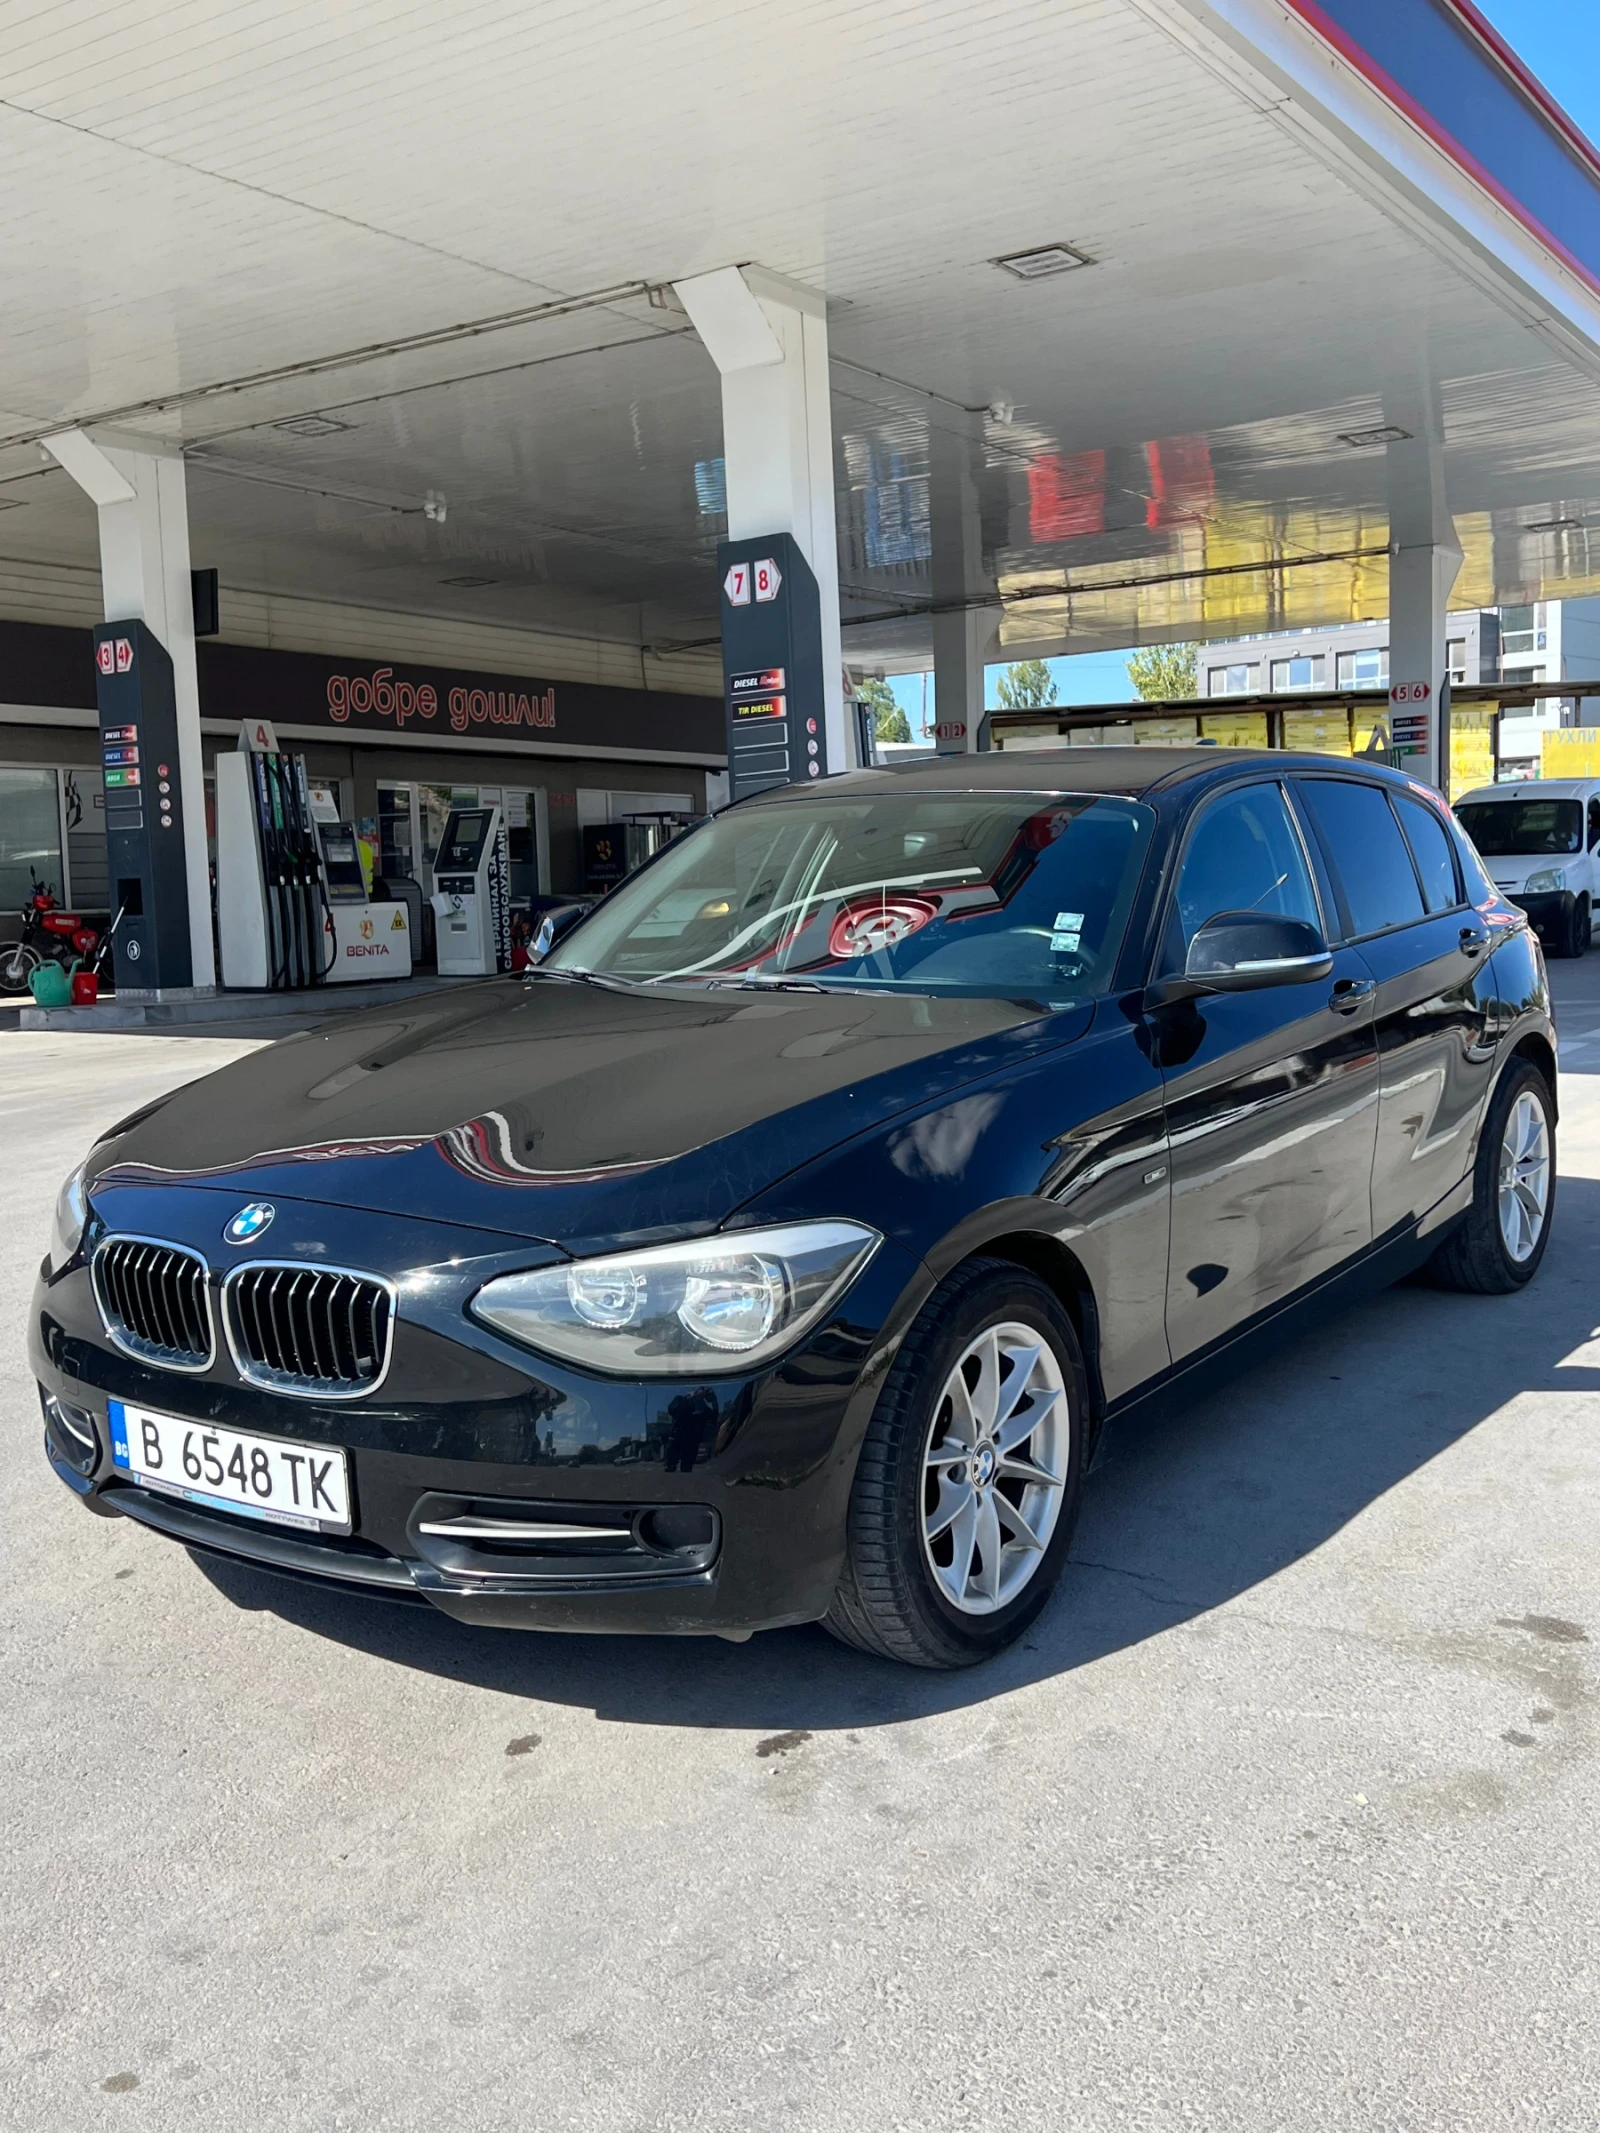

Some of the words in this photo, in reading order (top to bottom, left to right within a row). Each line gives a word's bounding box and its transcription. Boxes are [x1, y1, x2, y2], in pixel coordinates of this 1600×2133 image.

[734, 572, 744, 595] 7
[758, 569, 768, 591] 8
[103, 648, 110, 666] 3
[118, 646, 125, 664] 4
[733, 678, 758, 689] DIESEL
[1414, 685, 1421, 698] 6
[327, 667, 438, 726] добре
[449, 687, 556, 731] дошли!
[1399, 687, 1407, 700] 5
[738, 706, 750, 715] TIR
[750, 704, 774, 714] DIESEL
[256, 725, 269, 747] 4
[1546, 730, 1597, 745] ТУХЛИ
[489, 855, 498, 875] ЗА
[346, 944, 390, 957] BENITA
[115, 1440, 129, 1458] BG
[141, 1418, 163, 1470] B
[183, 1431, 273, 1498] 6548
[280, 1452, 338, 1513] TK
